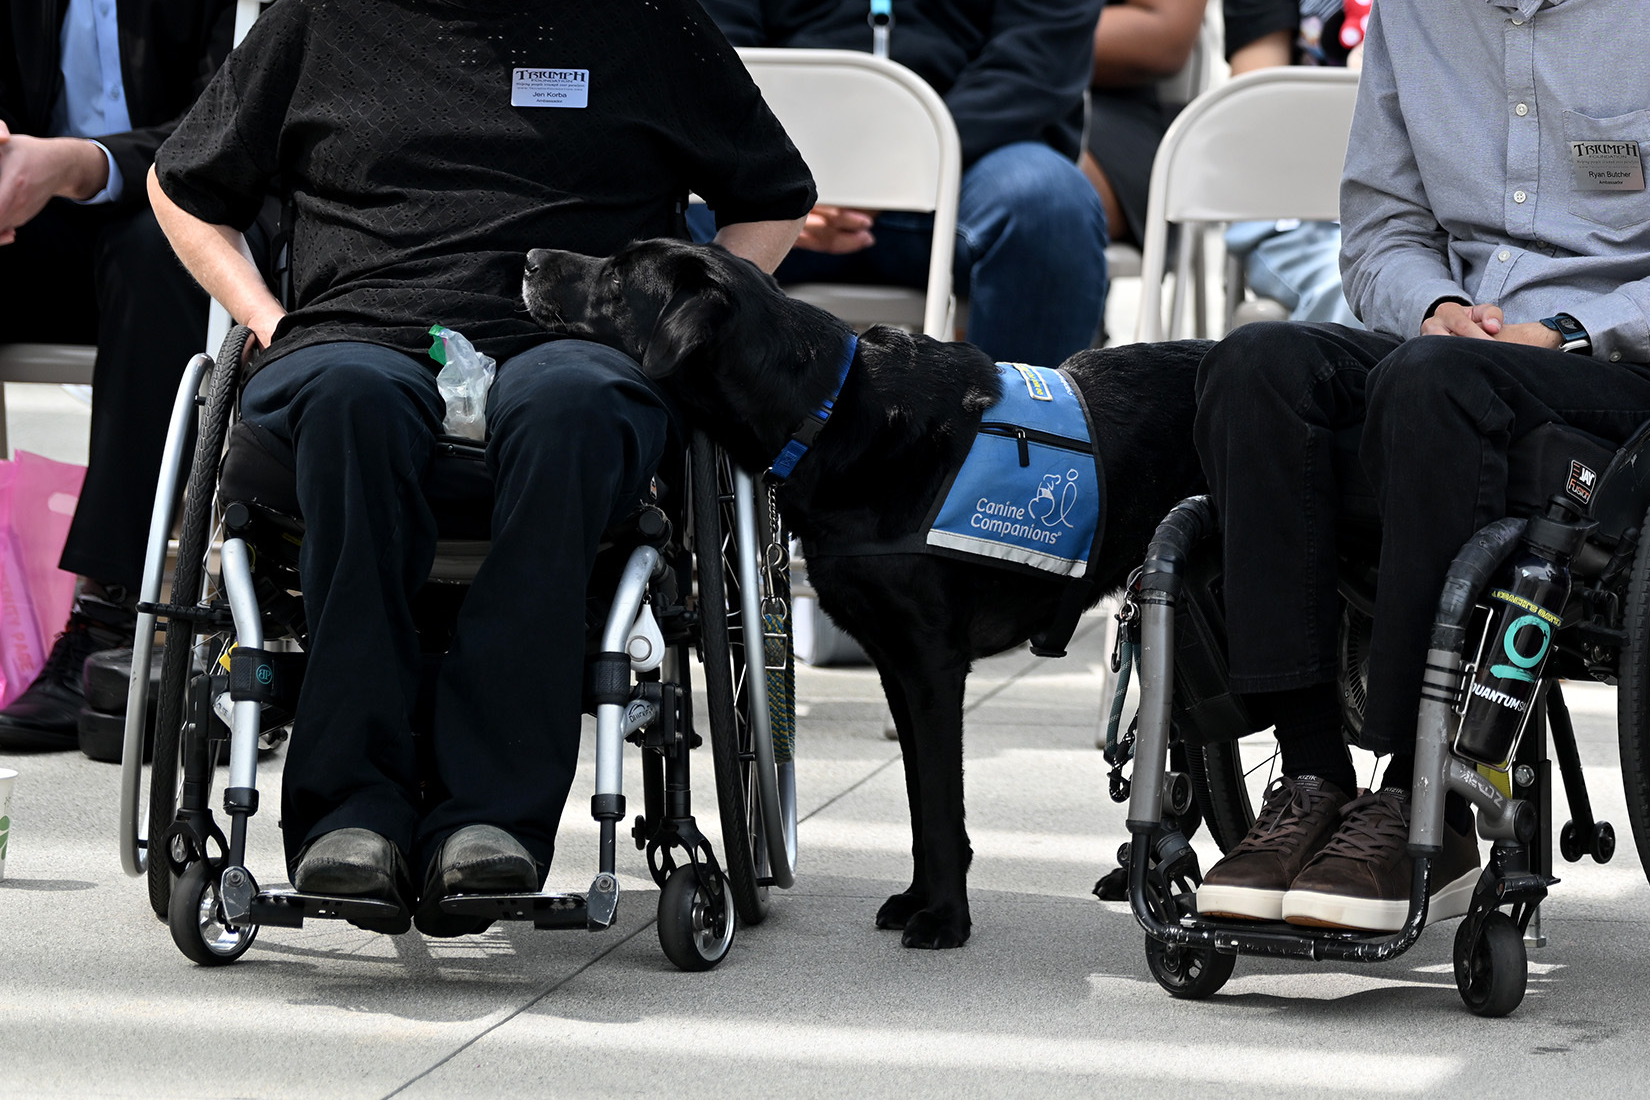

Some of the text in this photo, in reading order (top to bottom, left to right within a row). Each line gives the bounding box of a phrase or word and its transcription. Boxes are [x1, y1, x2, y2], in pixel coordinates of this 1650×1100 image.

[1574, 143, 1638, 157] TRIUMPH
[1589, 171, 1606, 179] Ryan
[976, 497, 1025, 520] Canine
